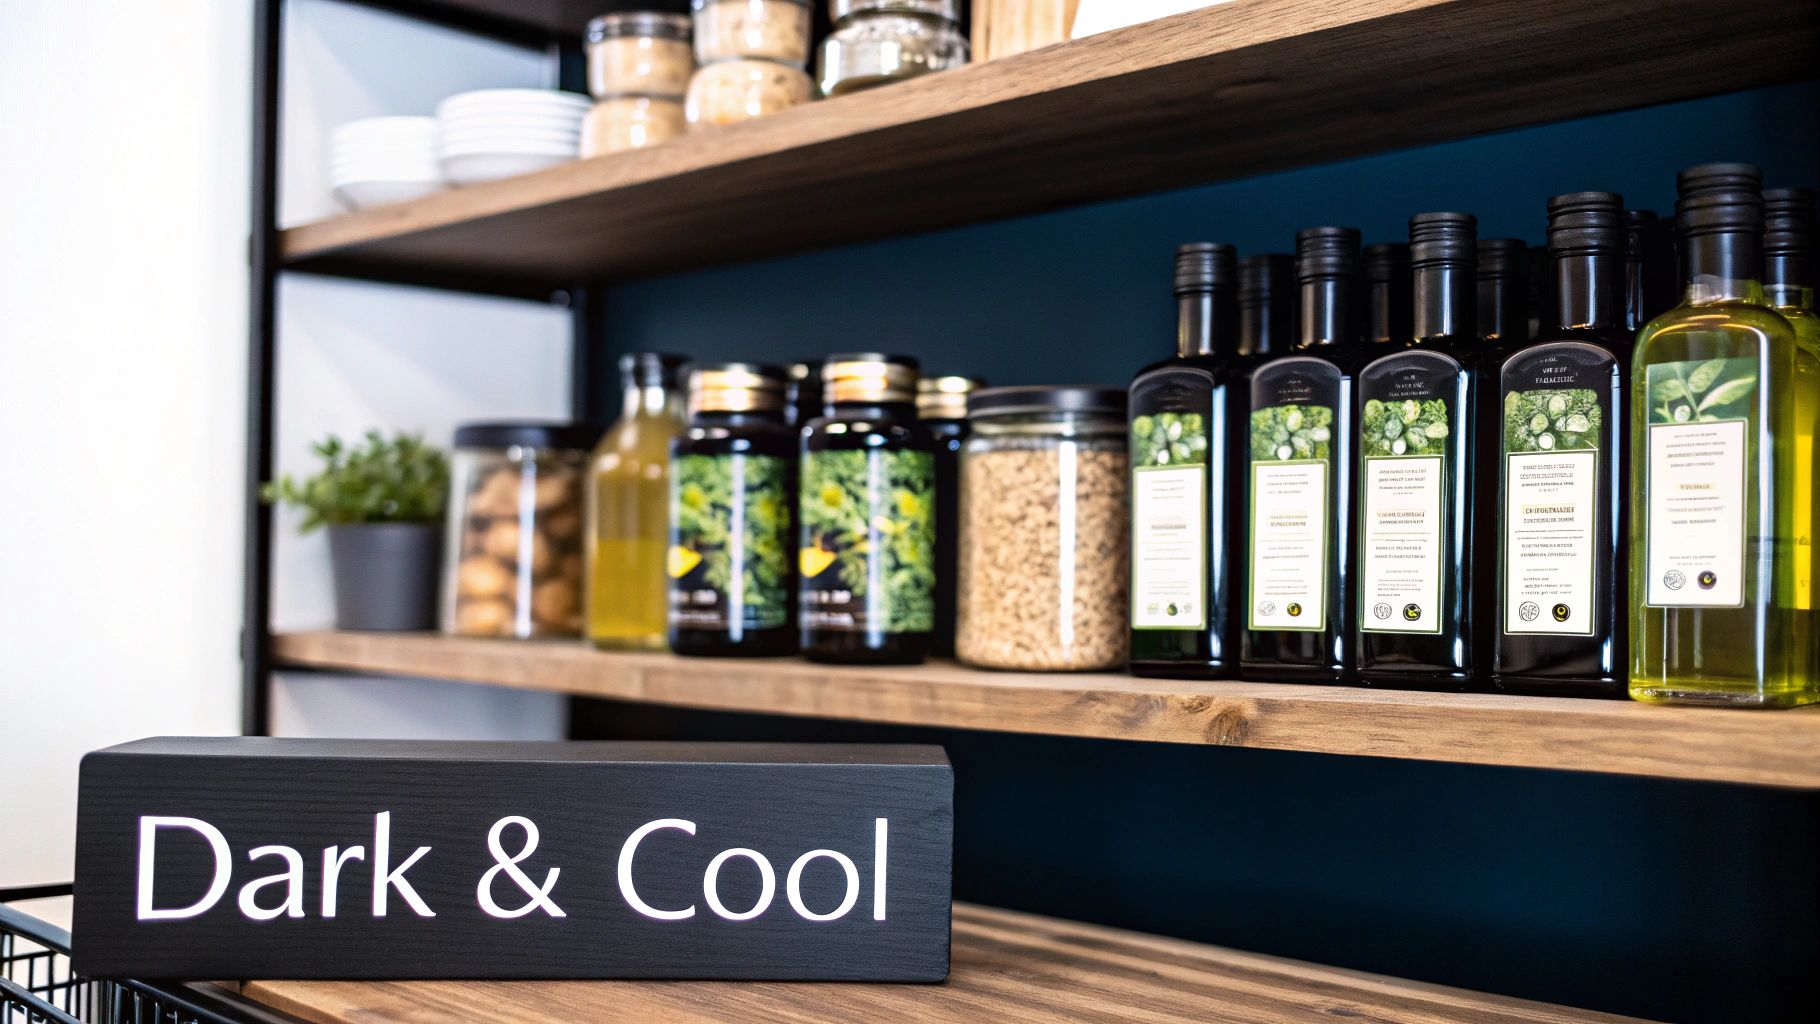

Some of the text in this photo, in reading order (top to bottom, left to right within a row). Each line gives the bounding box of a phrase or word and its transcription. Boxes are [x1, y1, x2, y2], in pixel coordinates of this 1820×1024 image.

[136, 811, 888, 922] Dark & Cool
